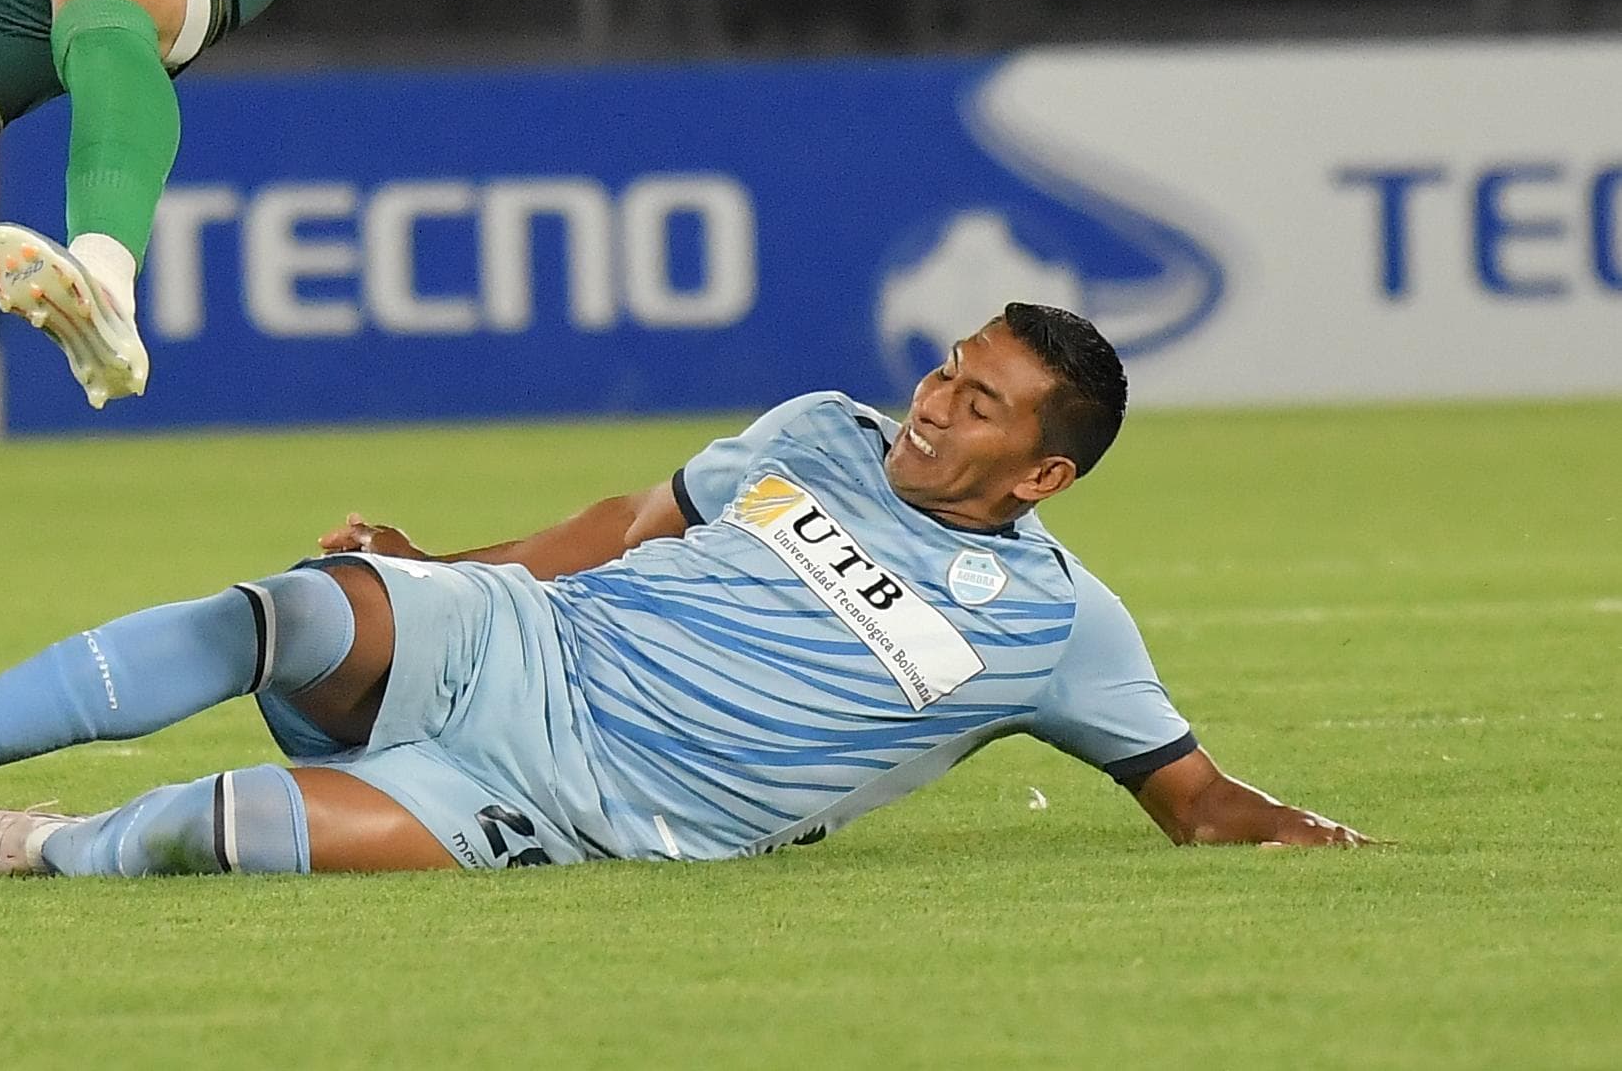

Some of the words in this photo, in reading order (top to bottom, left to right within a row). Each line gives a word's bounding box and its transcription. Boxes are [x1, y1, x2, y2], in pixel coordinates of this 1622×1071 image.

[148, 171, 762, 340] TECNO
[773, 529, 837, 592] Universidad
[833, 588, 894, 652] Tecnológica
[892, 648, 933, 704] Boliviana
[792, 505, 904, 610] UTB
